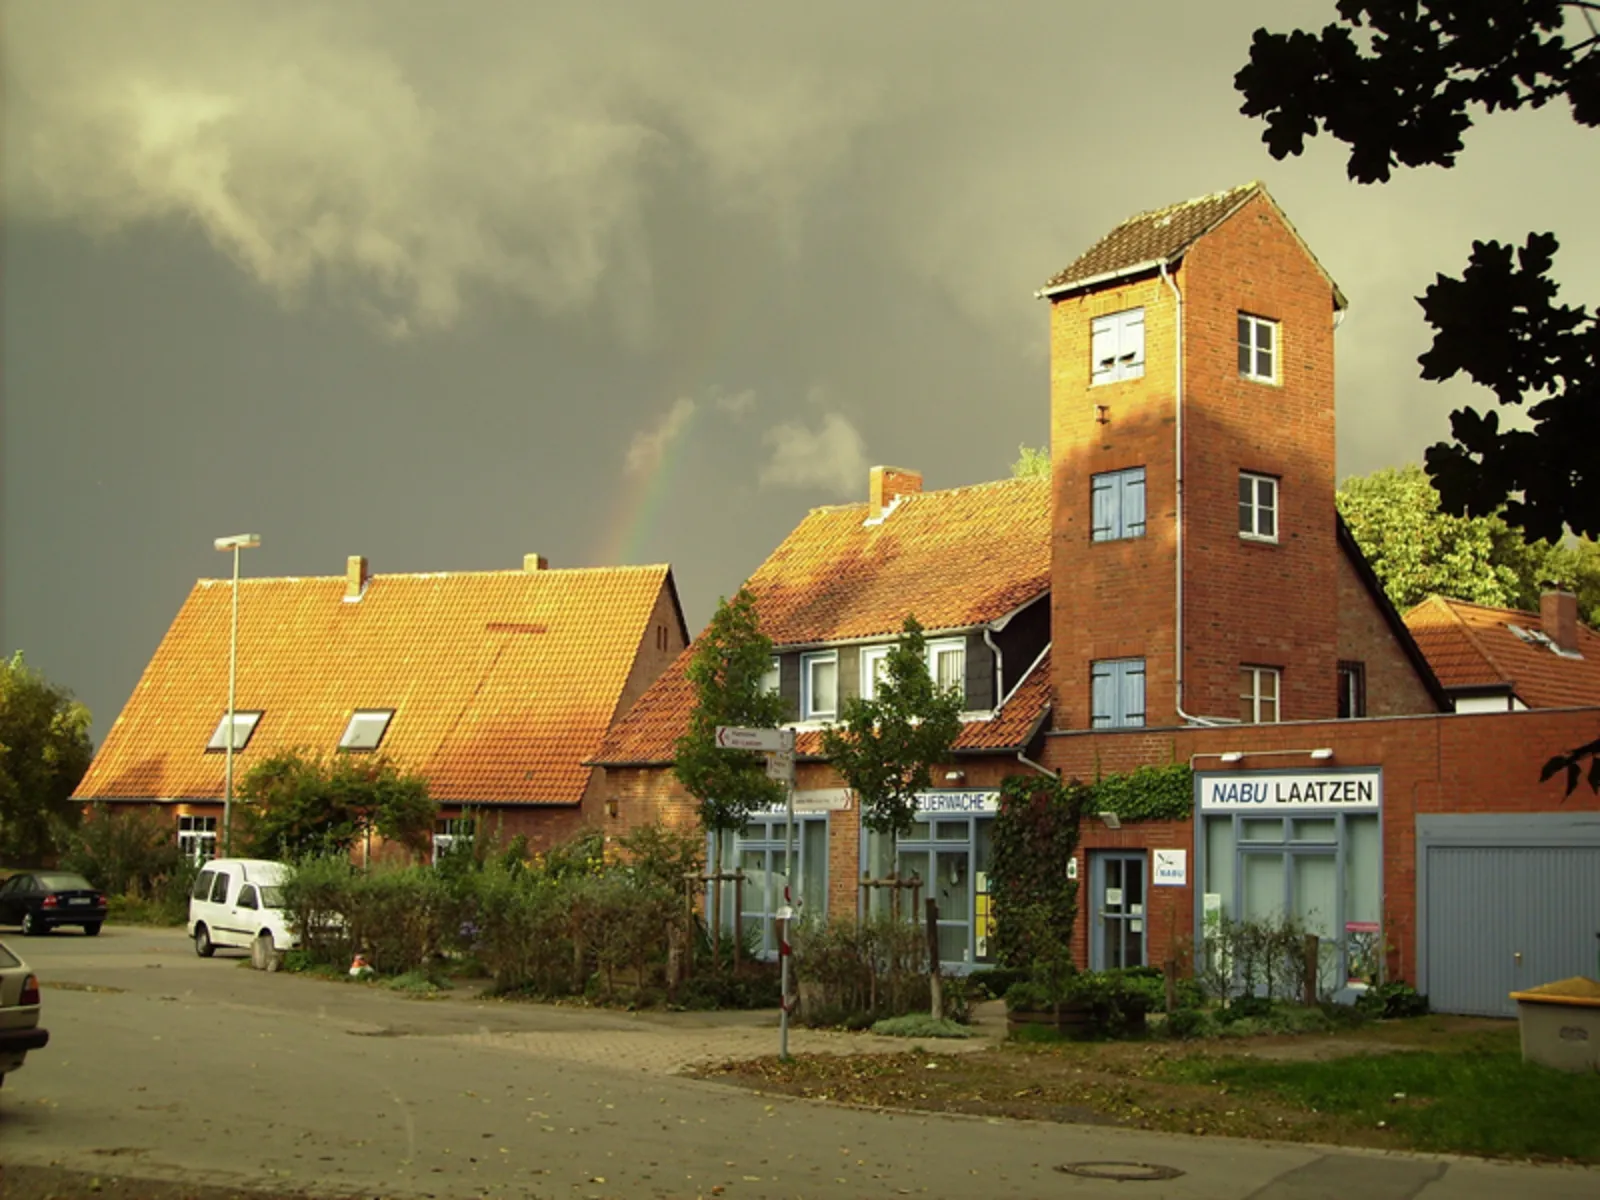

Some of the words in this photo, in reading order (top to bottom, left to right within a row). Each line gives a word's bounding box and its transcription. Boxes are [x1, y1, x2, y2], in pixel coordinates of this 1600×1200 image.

[1211, 782, 1268, 803] NABU
[1275, 780, 1372, 803] LAATZEN
[916, 793, 985, 811] EUERWACHE
